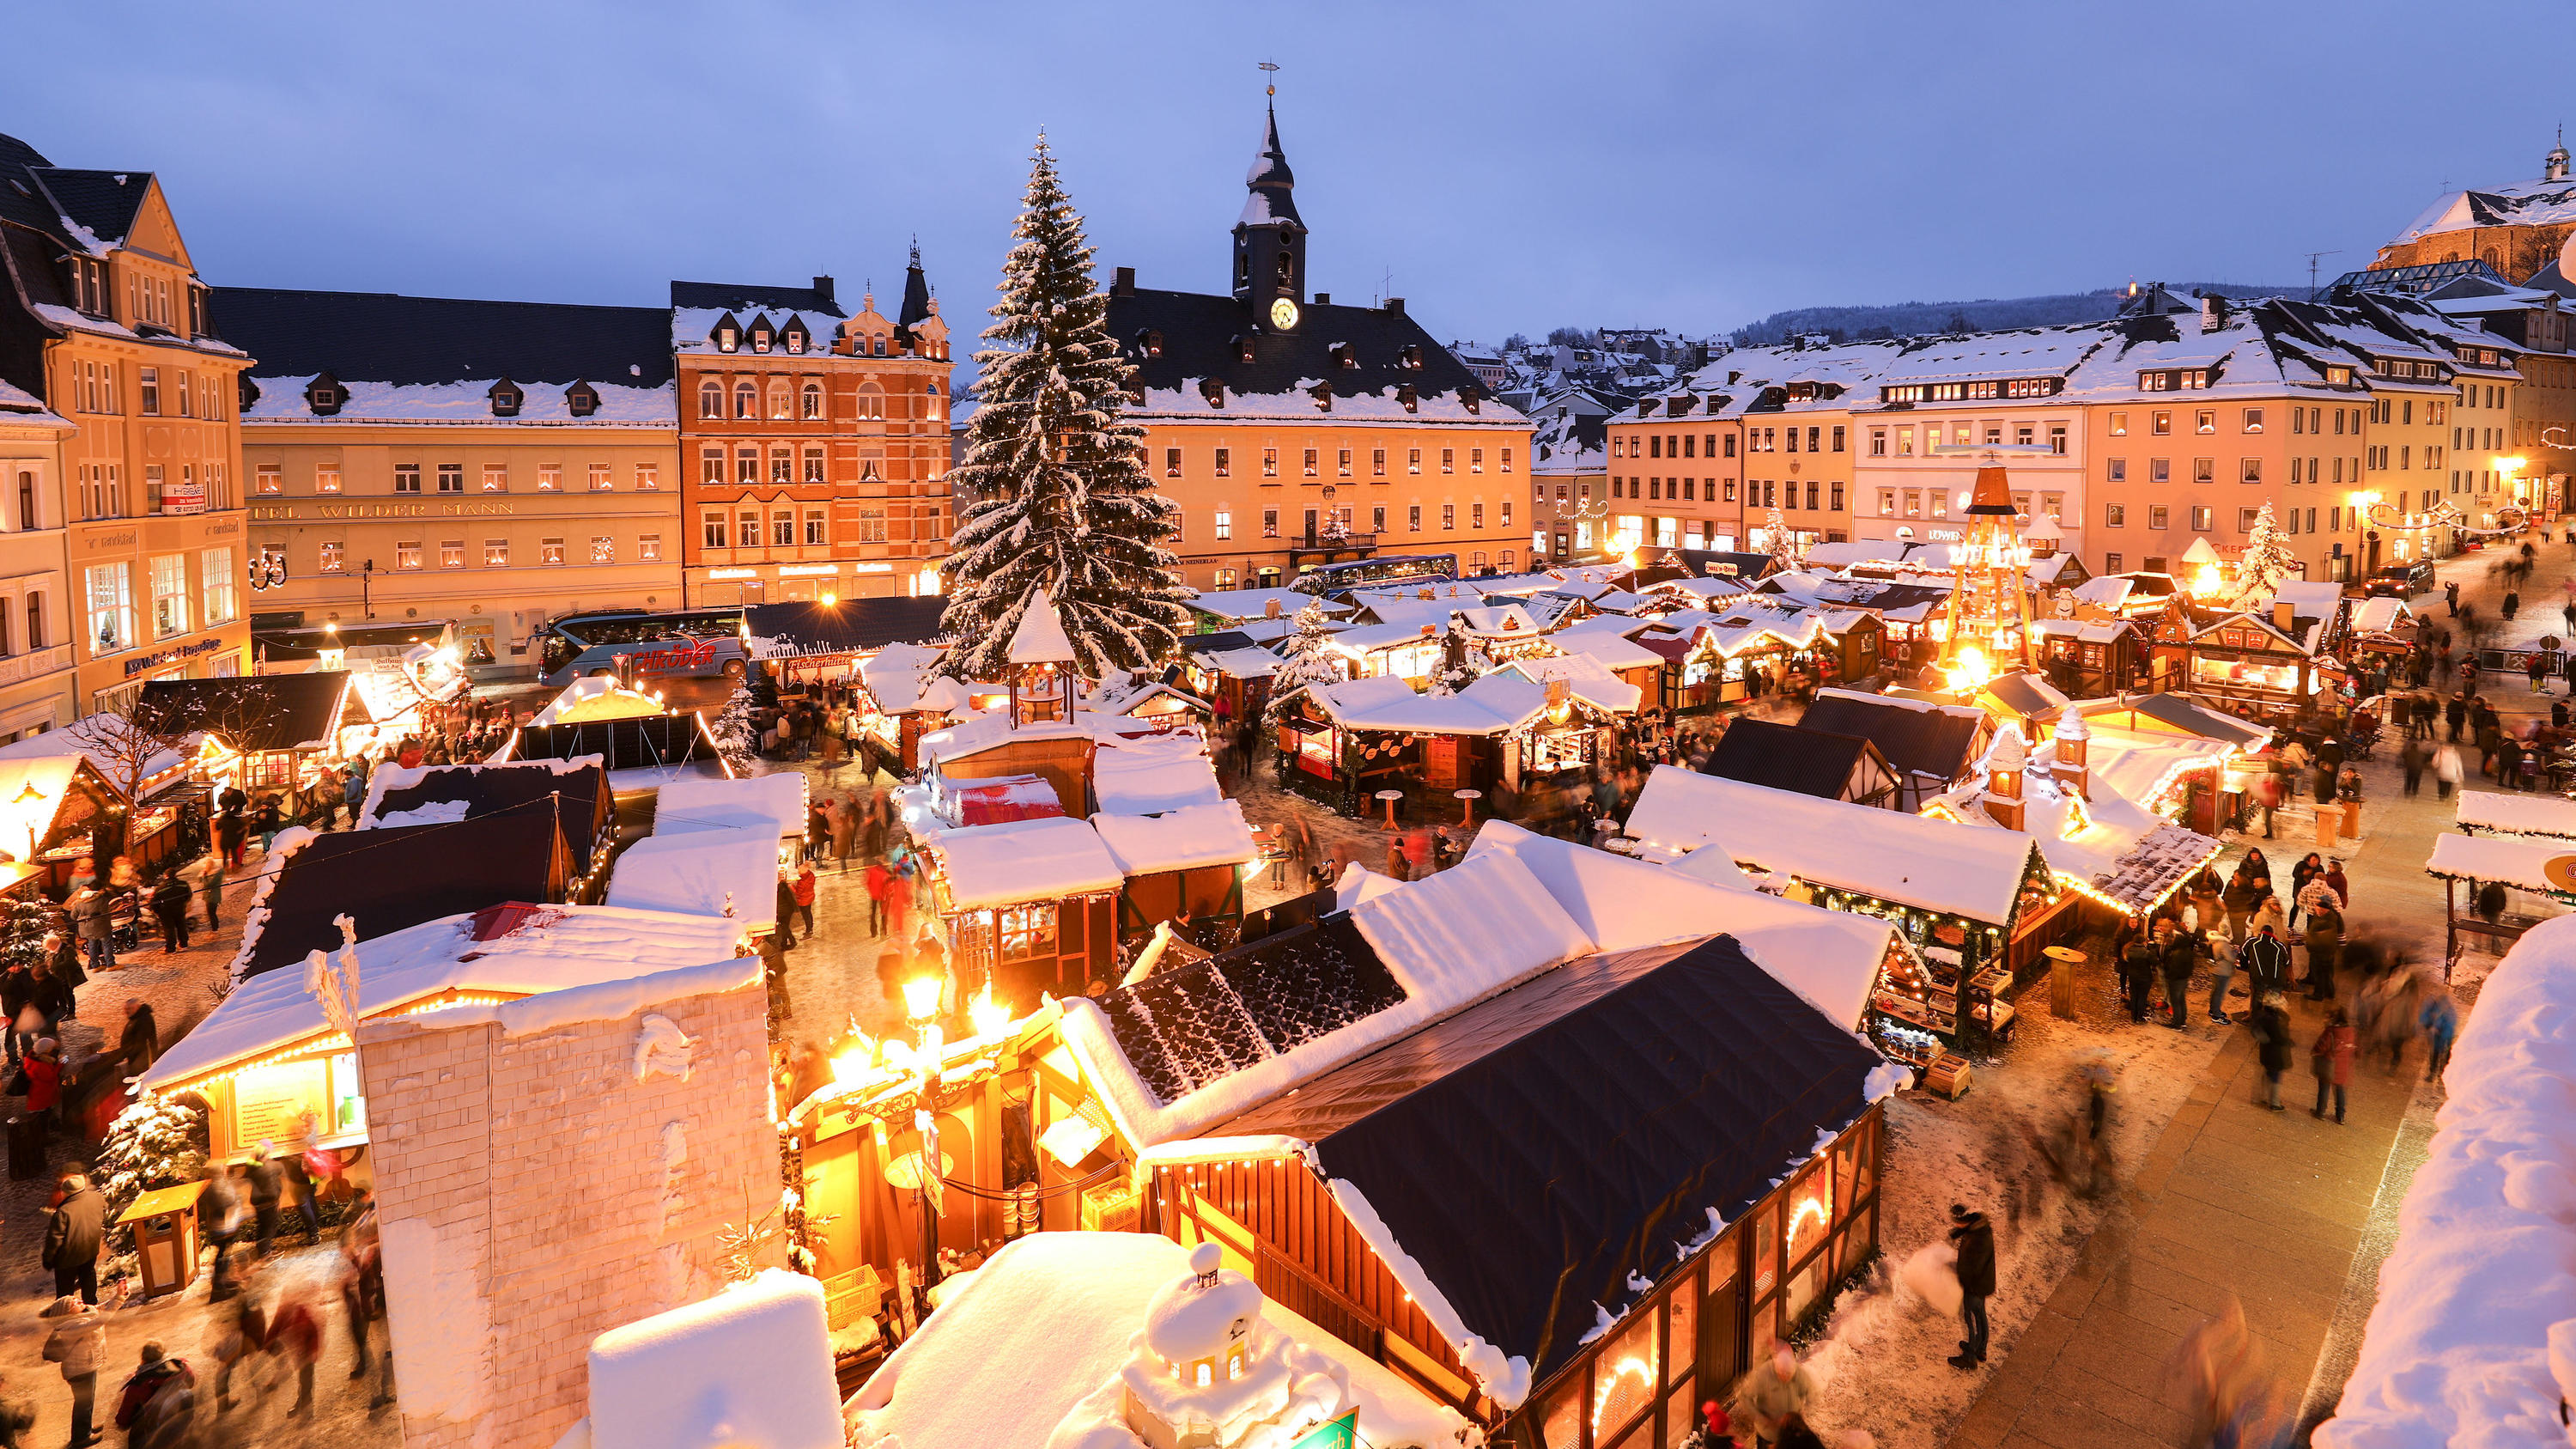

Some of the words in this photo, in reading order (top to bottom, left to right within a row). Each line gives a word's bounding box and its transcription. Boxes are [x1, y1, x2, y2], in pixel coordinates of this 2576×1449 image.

[252, 505, 301, 519] TEL
[318, 503, 425, 518] WILDER
[441, 502, 513, 515] MANN
[214, 521, 239, 534] randstad
[101, 529, 137, 548] randstad
[142, 647, 185, 669] Volksbank
[628, 643, 717, 672] CHRÖDER
[788, 656, 850, 670] Fischerhütte
